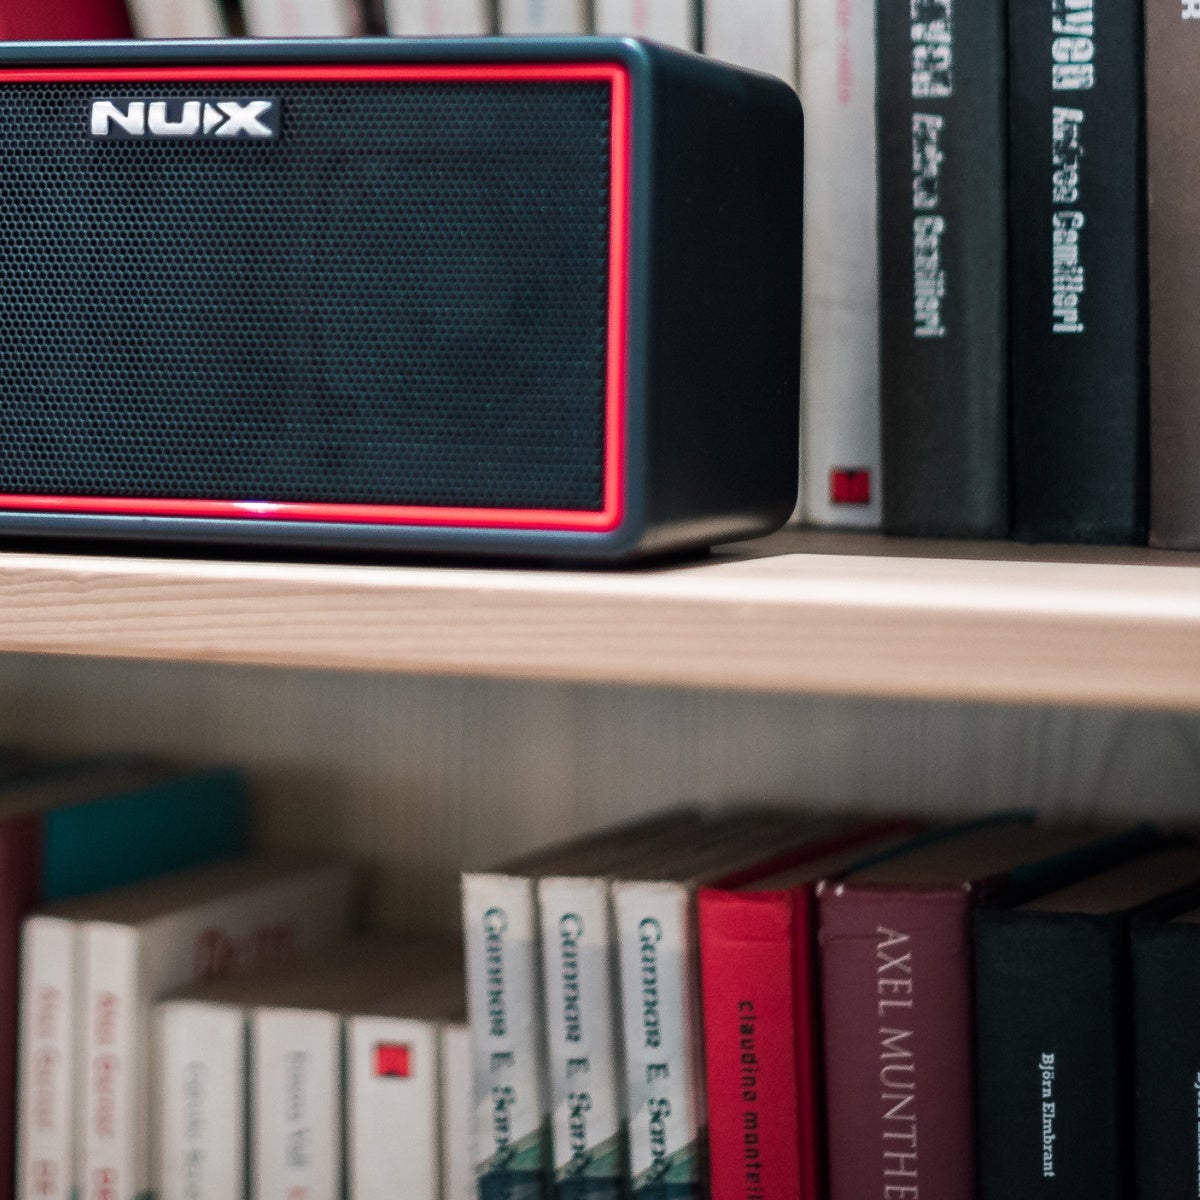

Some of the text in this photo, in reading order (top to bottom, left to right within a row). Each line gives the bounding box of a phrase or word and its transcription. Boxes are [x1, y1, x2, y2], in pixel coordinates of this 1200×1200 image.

[91, 100, 273, 137] NUX
[876, 926, 919, 1200] AXEL MUNTHE
[1038, 1053, 1056, 1178] Björn Elmbrant
